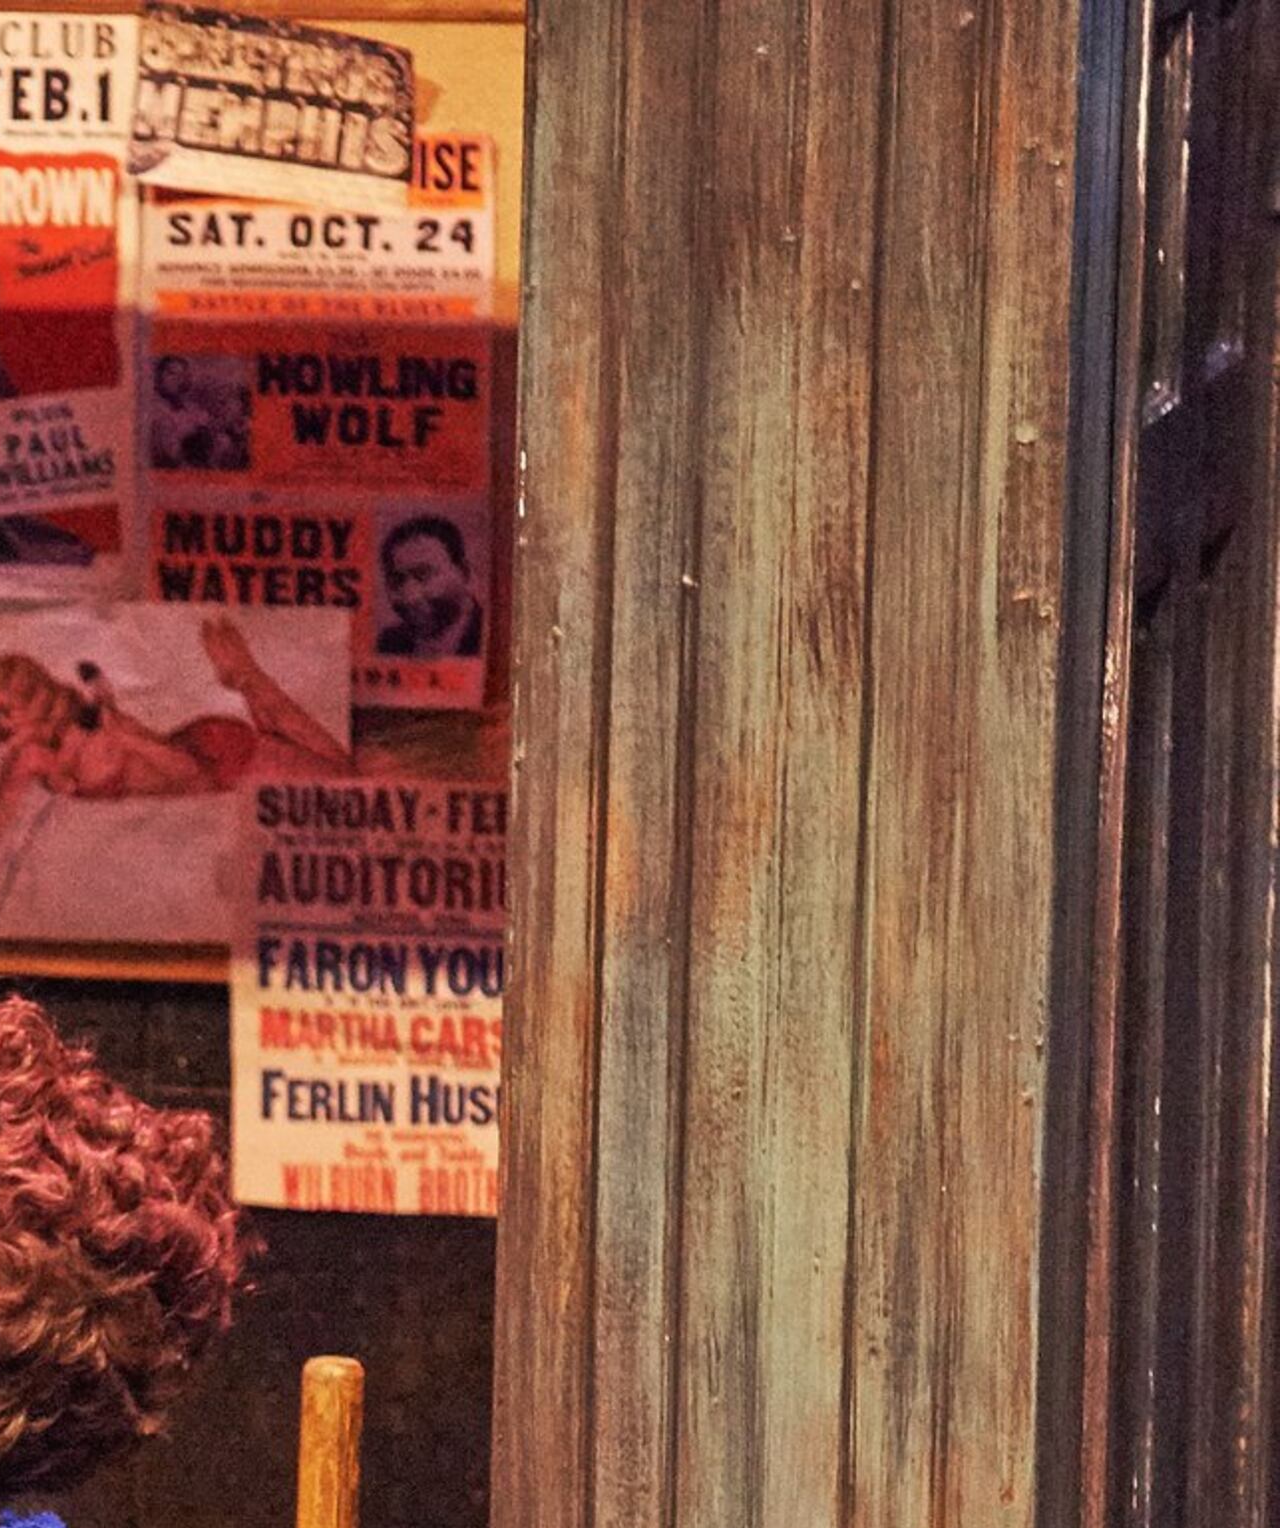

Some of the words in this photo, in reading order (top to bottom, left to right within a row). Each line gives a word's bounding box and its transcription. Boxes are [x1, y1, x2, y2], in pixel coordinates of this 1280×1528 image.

[0, 21, 116, 59] CLUB
[134, 77, 409, 178] MEMPHIS
[168, 212, 265, 247] SAT.
[289, 215, 392, 252] OCT.
[415, 219, 475, 254] 24
[257, 353, 478, 400] HOWLING
[4, 425, 86, 457] PAUL
[293, 403, 443, 447] WOLF
[163, 512, 353, 560] MUDDY
[157, 562, 362, 607] WATERS
[258, 937, 407, 995] FARON
[260, 1006, 401, 1053] MARTHA
[262, 1069, 395, 1124] FERLIN
[410, 1075, 500, 1126] HUS
